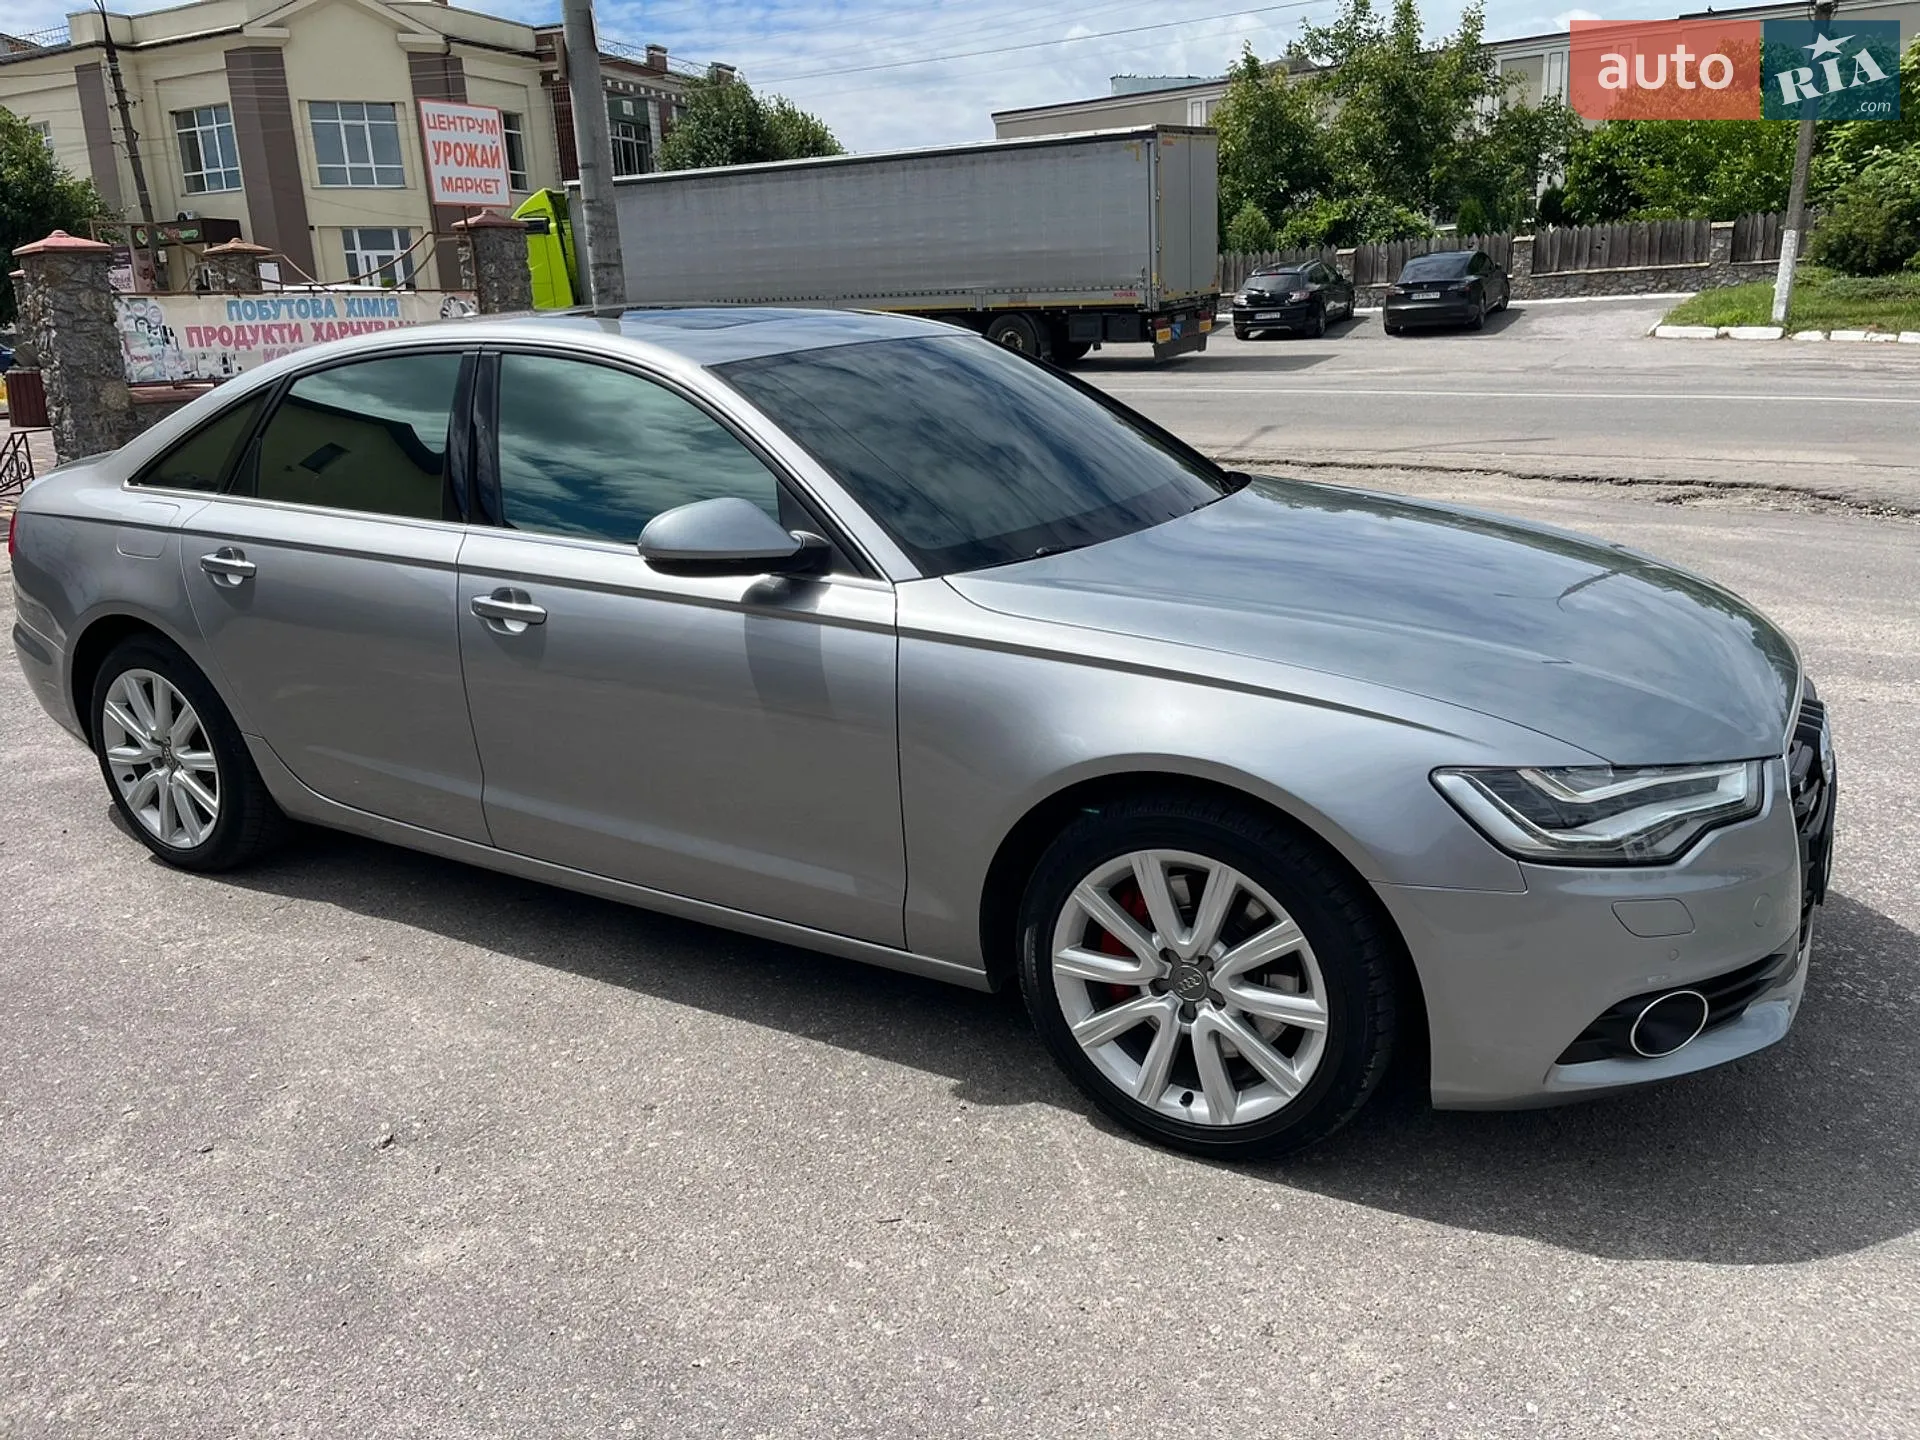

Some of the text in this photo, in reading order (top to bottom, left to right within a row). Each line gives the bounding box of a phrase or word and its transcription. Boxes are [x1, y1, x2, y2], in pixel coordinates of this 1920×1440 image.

[425, 112, 499, 136] ЦЕНТРУМ
[432, 139, 502, 169] УРОЖАЙ
[440, 175, 501, 195] МАРКЕТ
[226, 297, 400, 322] ПОБУТОВА ХІМІЯ
[185, 322, 304, 351] ПРОДУКТИ
